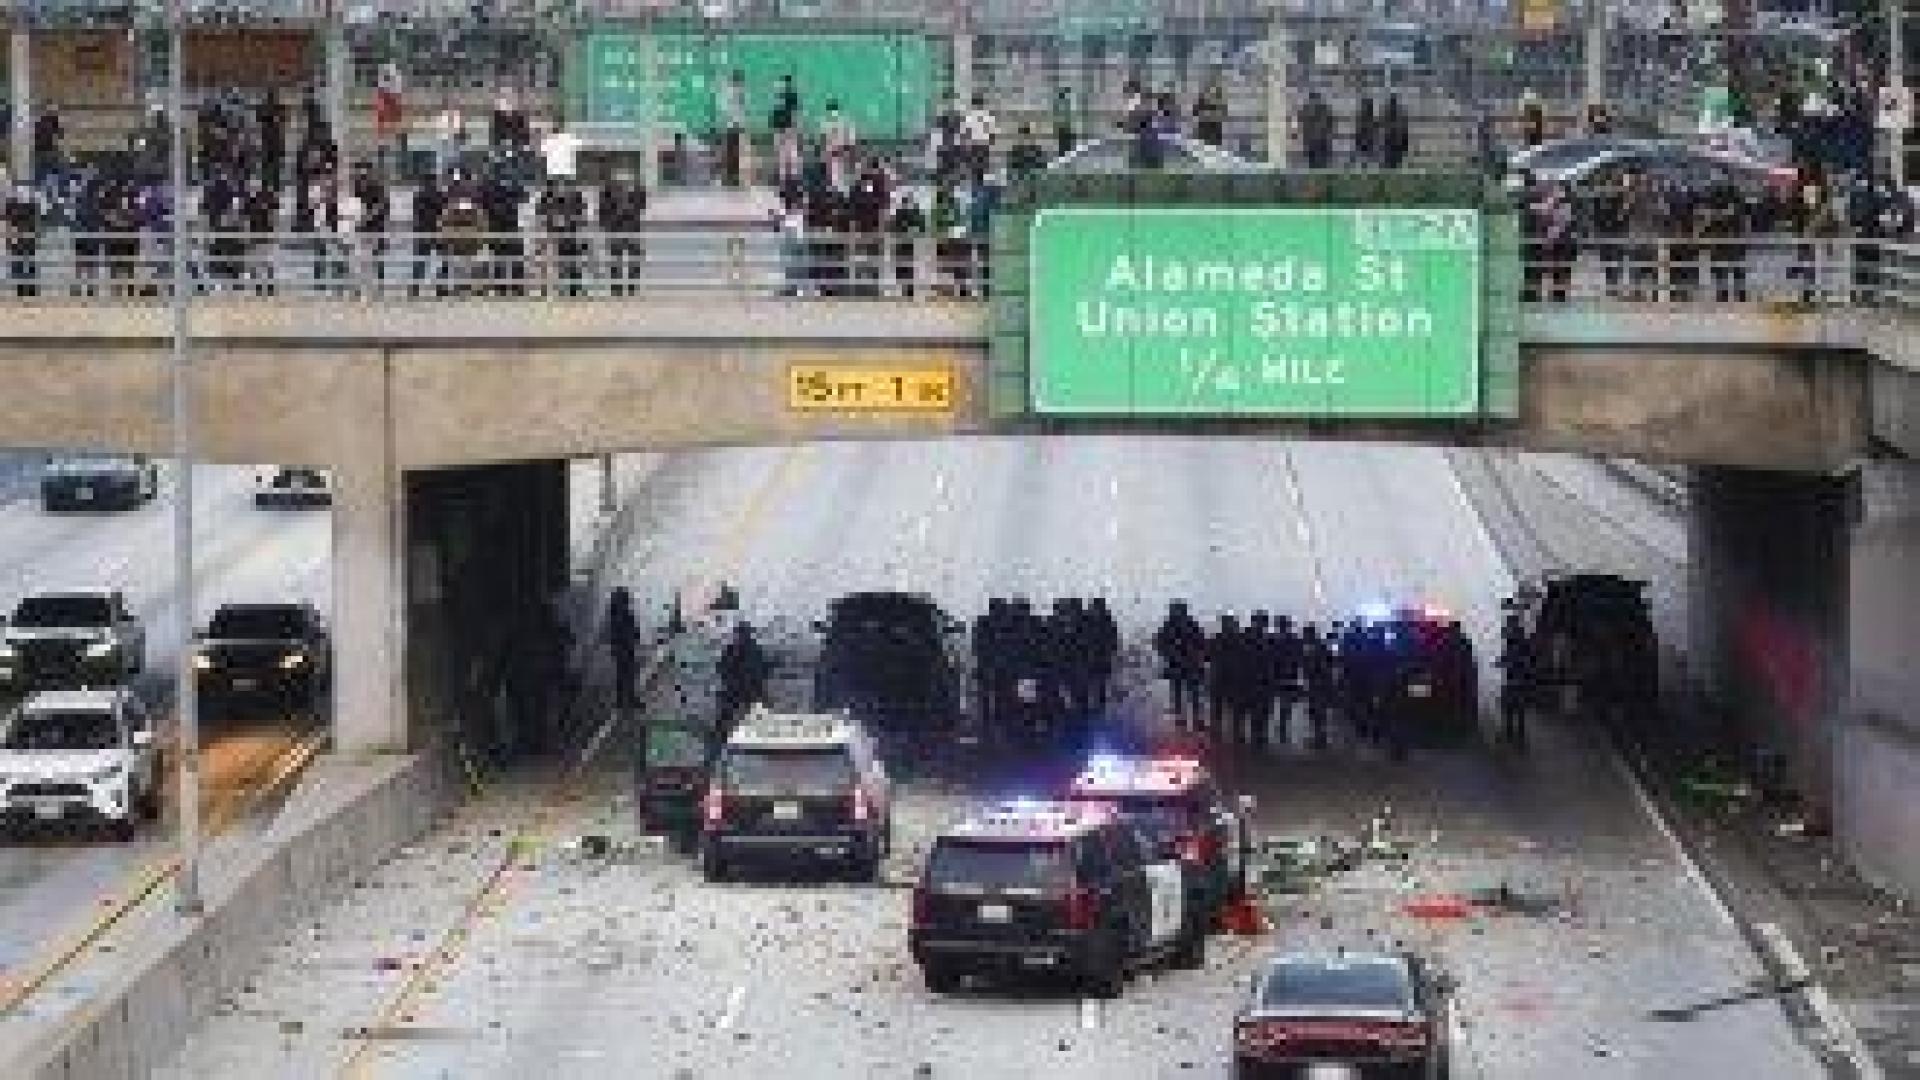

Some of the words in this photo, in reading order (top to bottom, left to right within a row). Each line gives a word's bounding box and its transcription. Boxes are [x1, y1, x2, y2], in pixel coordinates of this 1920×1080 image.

[1105, 253, 1328, 291] Alameda
[1356, 253, 1410, 291] St
[1075, 301, 1217, 337] Union
[1250, 301, 1432, 337] Station
[1262, 353, 1345, 384] MILE
